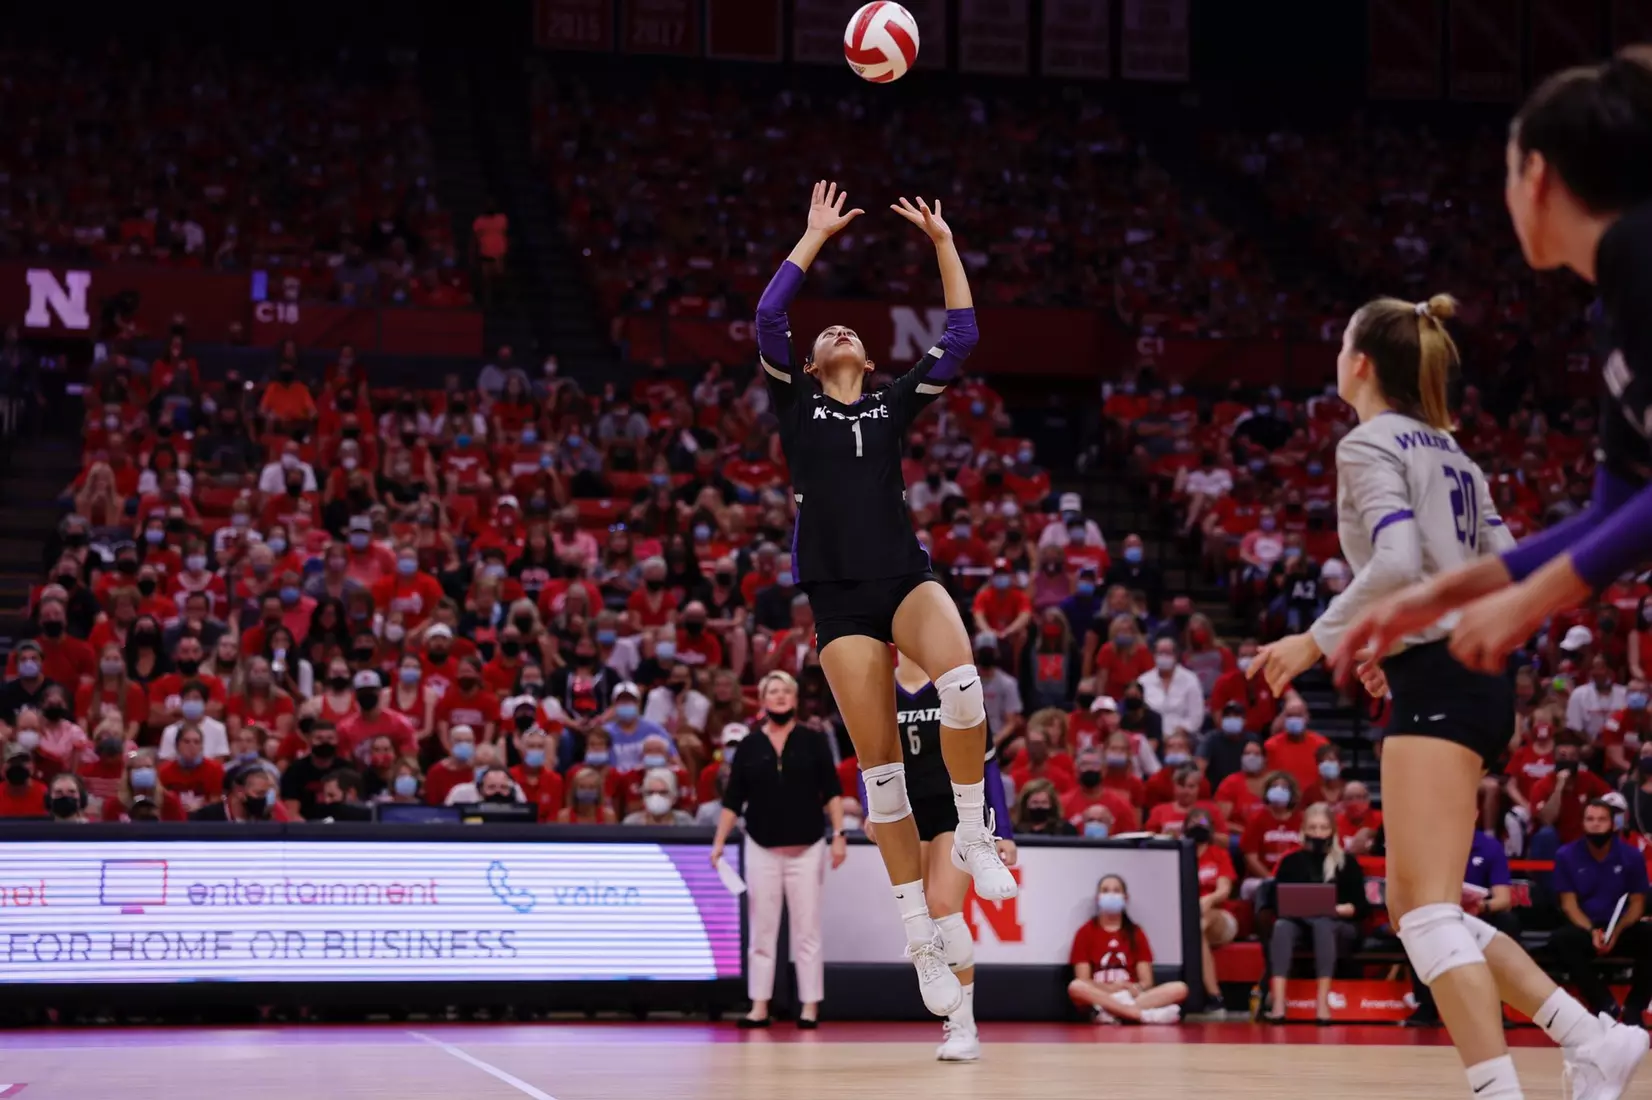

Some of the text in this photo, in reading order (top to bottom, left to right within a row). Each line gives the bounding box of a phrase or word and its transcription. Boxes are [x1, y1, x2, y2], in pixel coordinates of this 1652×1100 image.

[24, 267, 92, 330] N
[888, 305, 949, 363] N
[851, 420, 864, 458] 1
[1441, 463, 1479, 550] 20
[897, 707, 942, 724] STATE
[906, 723, 922, 756] 6
[187, 877, 439, 905] entertainment
[552, 878, 642, 906] voice
[963, 866, 1024, 943] N
[7, 929, 519, 962] FOR HOME OR BUSINESS
